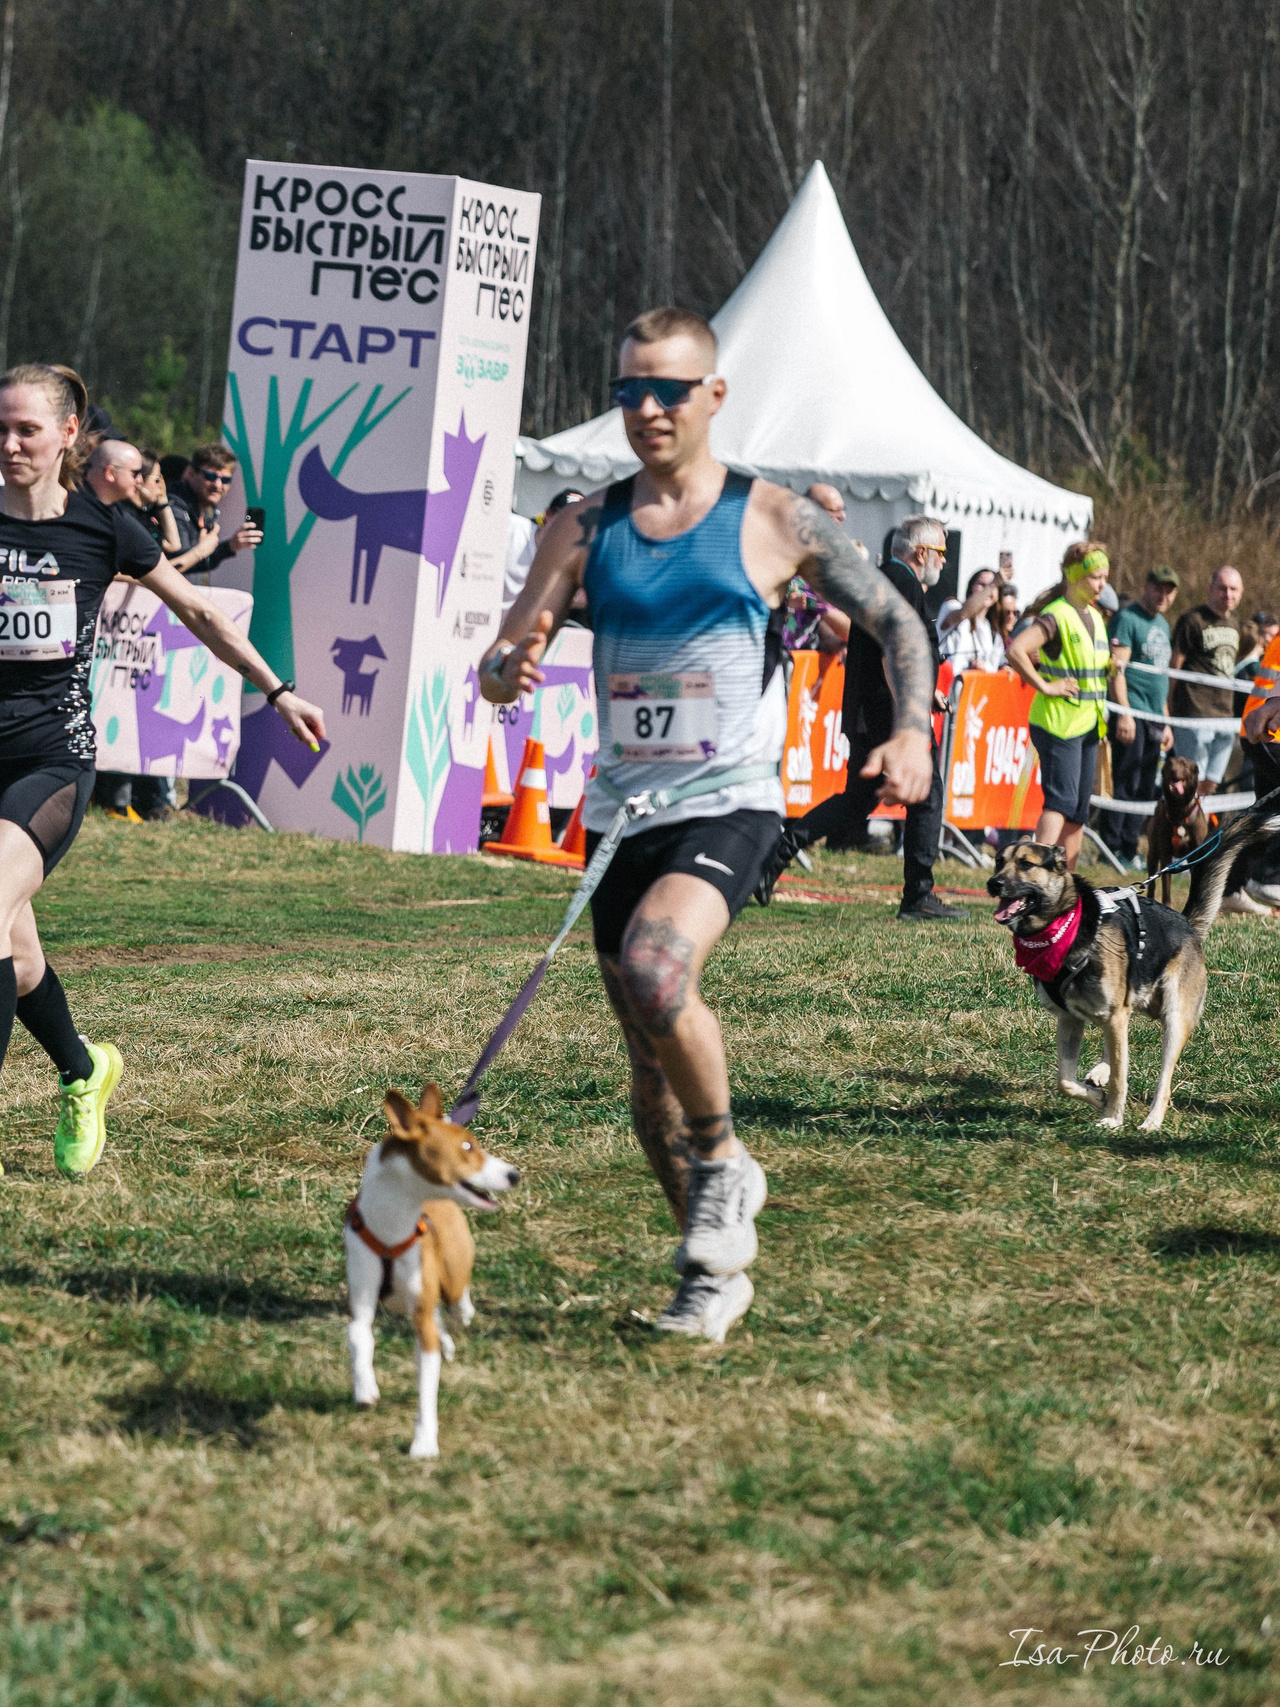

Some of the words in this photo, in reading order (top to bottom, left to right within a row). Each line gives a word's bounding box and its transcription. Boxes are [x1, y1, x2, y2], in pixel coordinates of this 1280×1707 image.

[253, 174, 406, 221] КРОСС
[460, 195, 518, 241] КРОСС
[237, 316, 436, 368] СТАРТ
[635, 705, 675, 739] 87
[983, 725, 1028, 786] 1945
